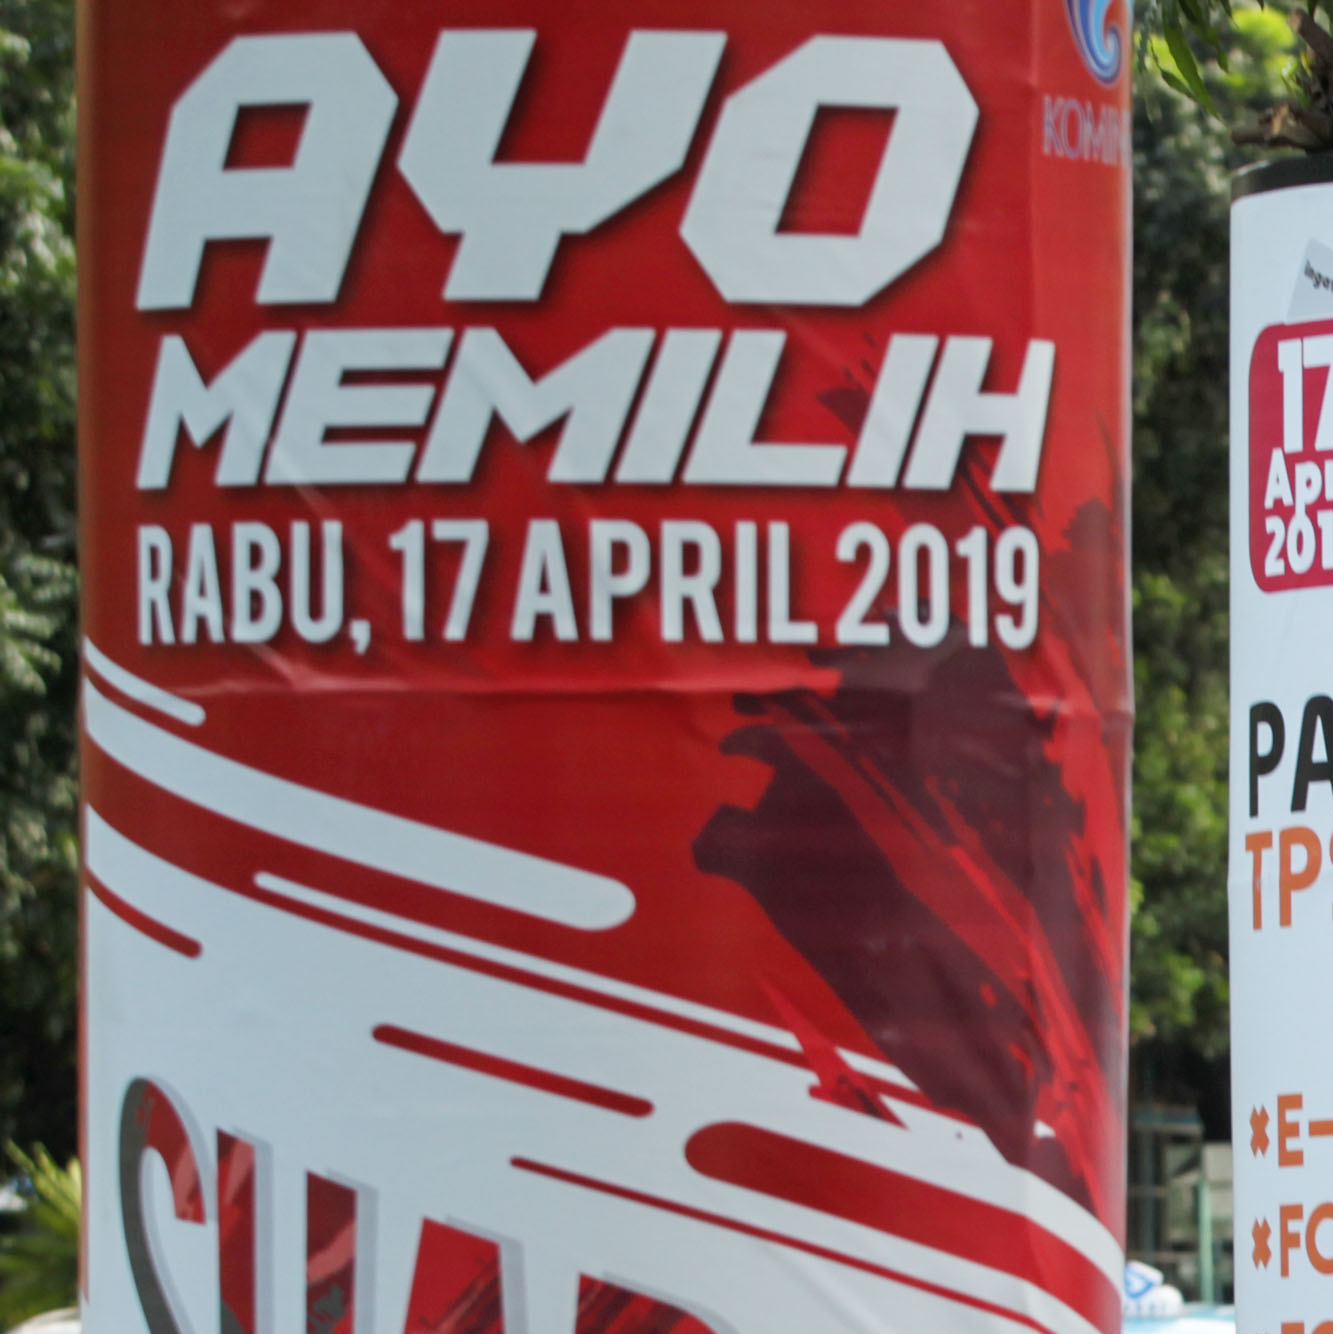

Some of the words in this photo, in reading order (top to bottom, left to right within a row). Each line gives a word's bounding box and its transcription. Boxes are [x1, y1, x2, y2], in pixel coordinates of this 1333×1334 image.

[136, 28, 979, 311] AYO
[136, 327, 1055, 493] MEMILIH
[137, 522, 370, 655] RABU,
[388, 519, 490, 643] 17
[511, 520, 816, 644] APRIL
[834, 525, 1040, 652] 2019
